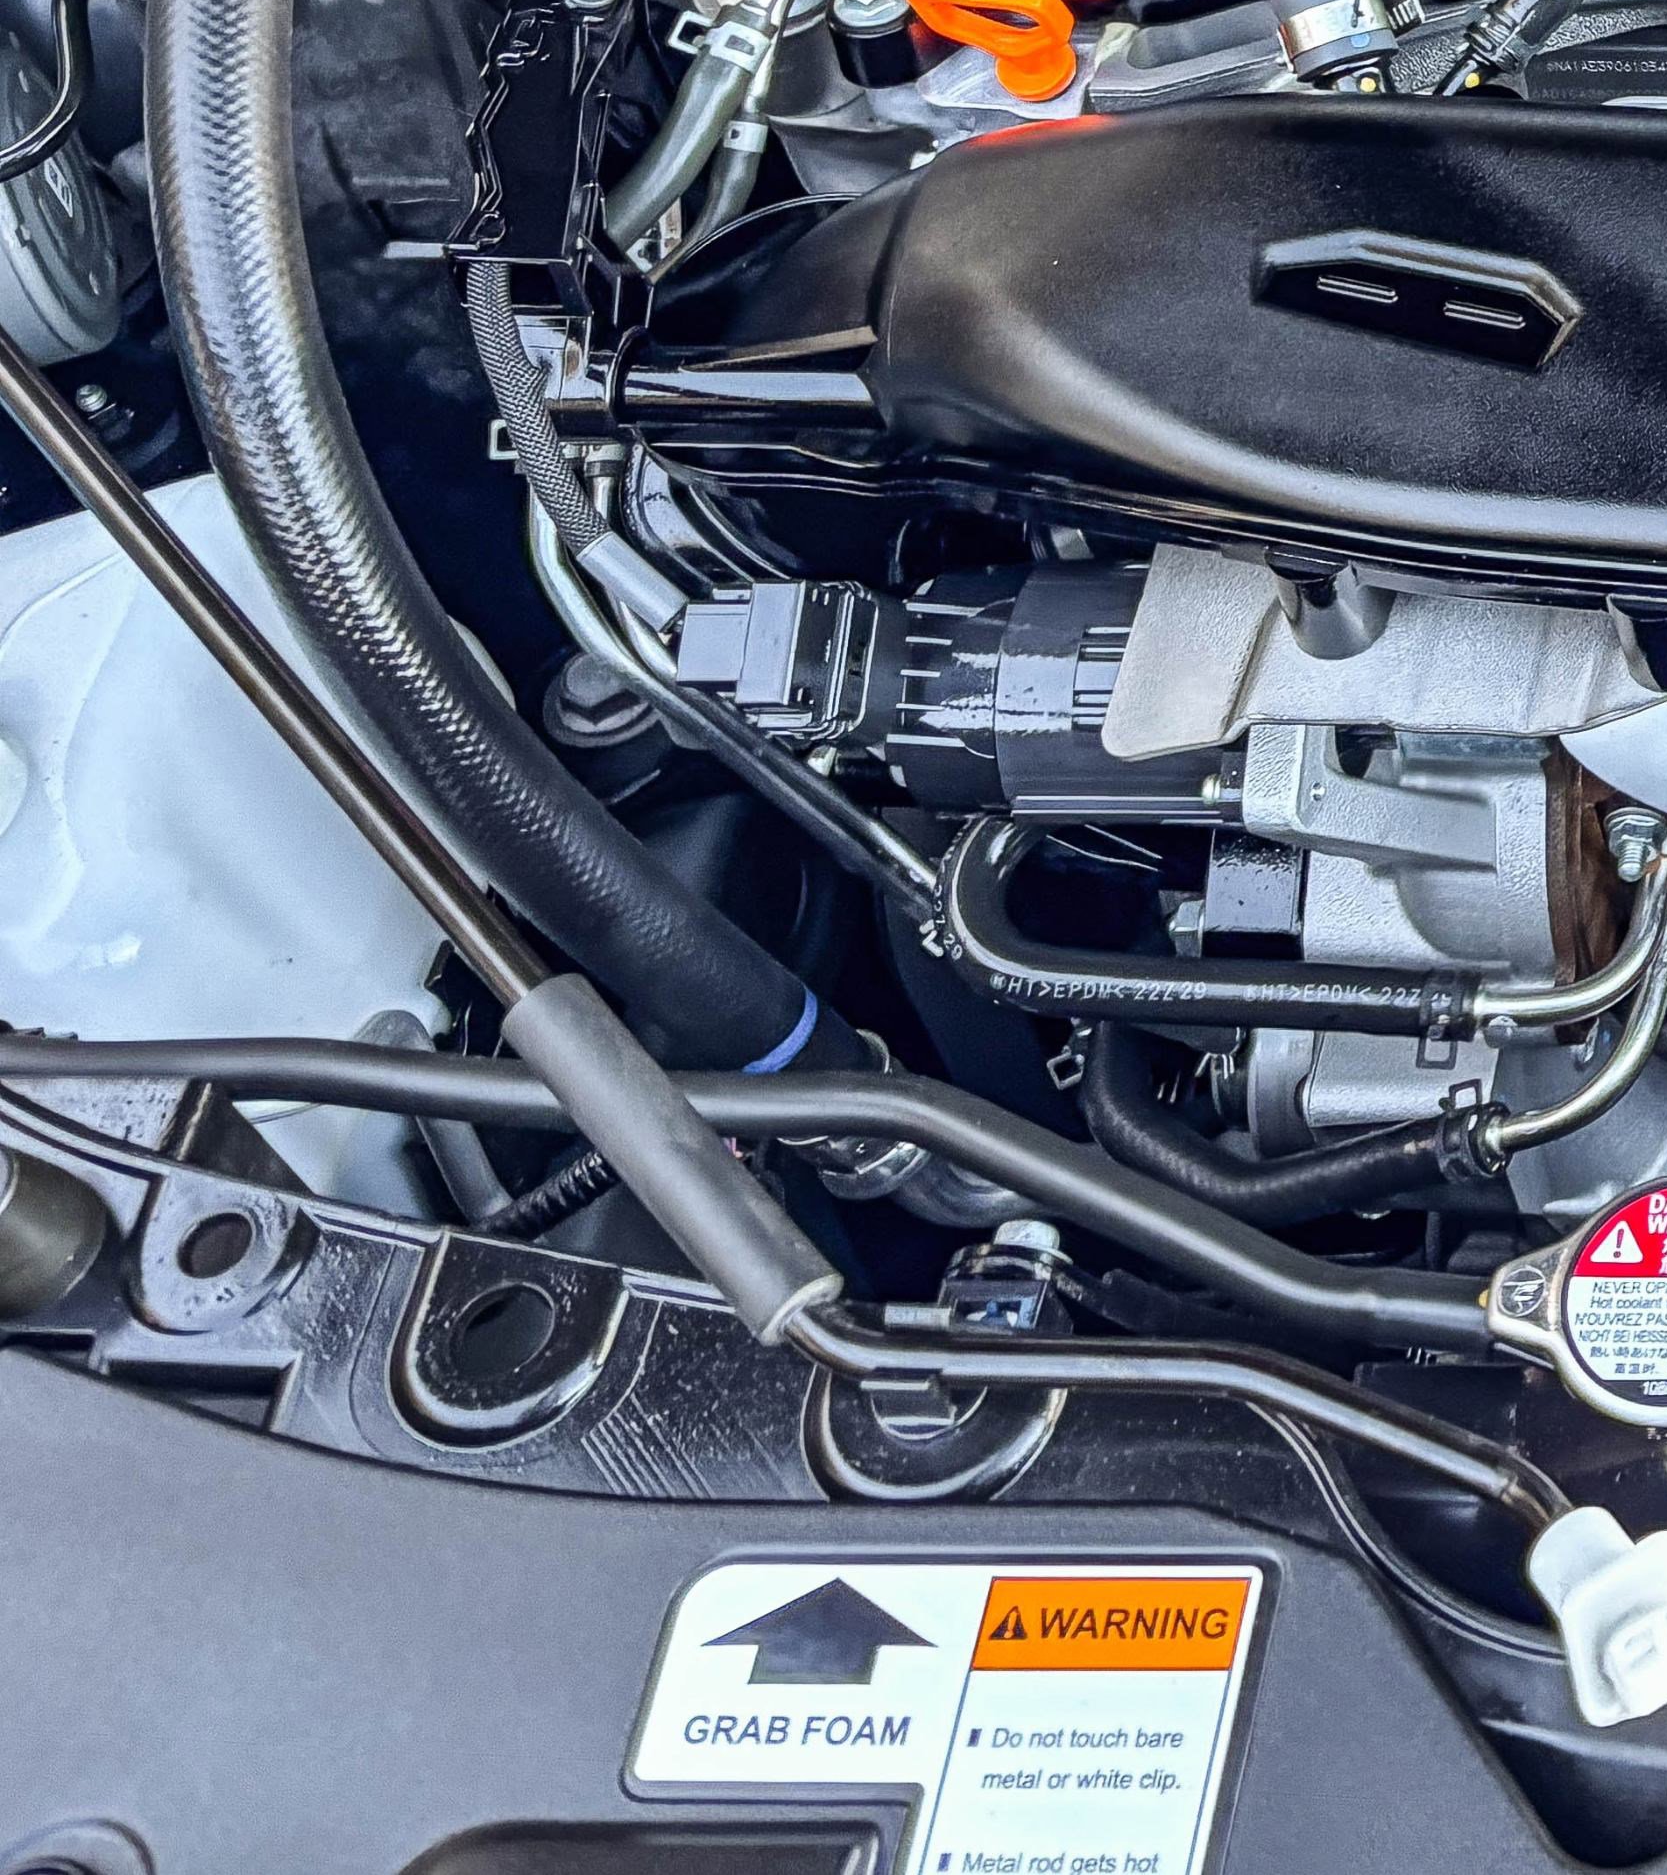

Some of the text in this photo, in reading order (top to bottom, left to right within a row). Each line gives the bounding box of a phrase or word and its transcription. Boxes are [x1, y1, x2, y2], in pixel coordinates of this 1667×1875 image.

[1593, 1281, 1641, 1294] NEVER
[1590, 1297, 1613, 1309] Hot
[1616, 1297, 1662, 1309] coolant
[1578, 1330, 1609, 1342] NICHT
[1613, 1330, 1630, 1342] BEI
[1039, 1606, 1230, 1640] WARNING
[683, 1714, 912, 1746] GRAB FOAM
[992, 1729, 1184, 1749] Do not touch bare
[981, 1770, 1182, 1795] metal or white clip.
[962, 1853, 1159, 1875] Metal rod gets hot
